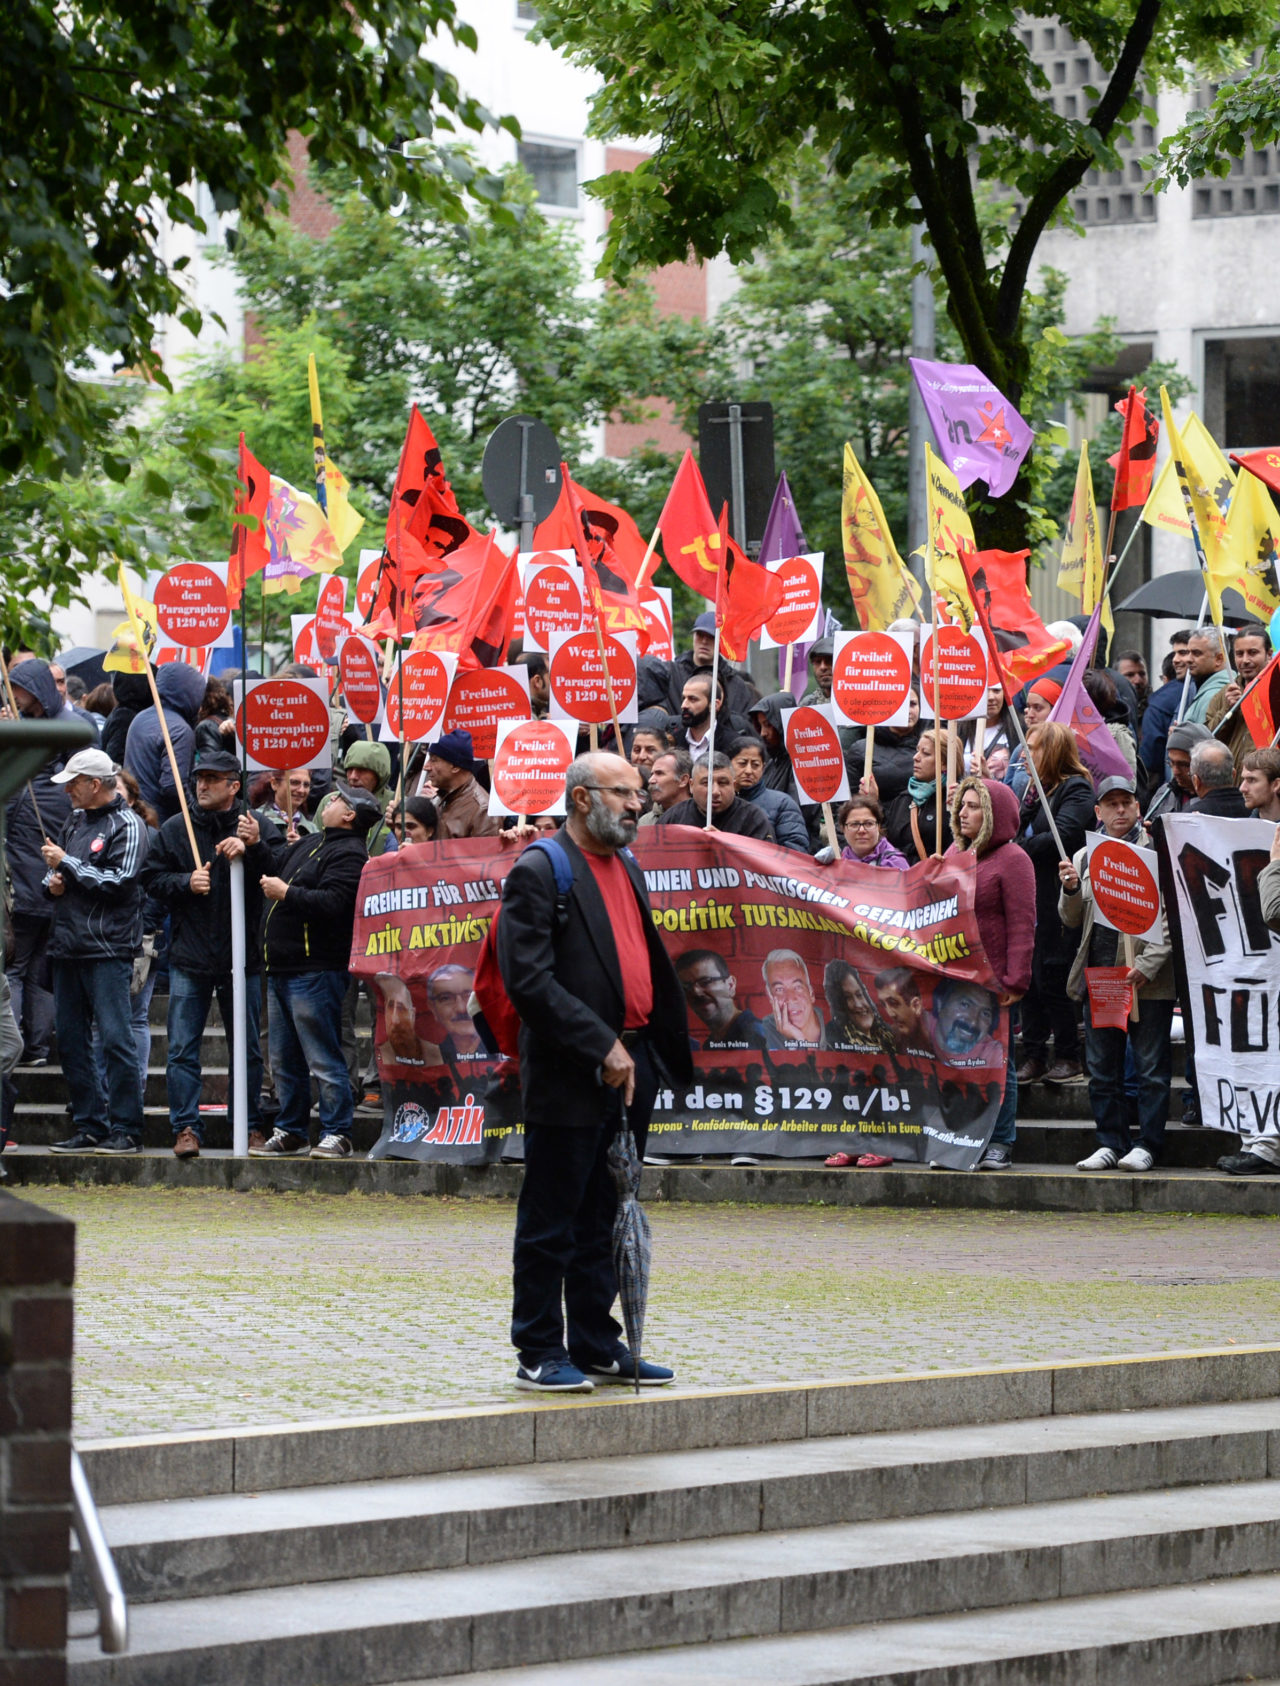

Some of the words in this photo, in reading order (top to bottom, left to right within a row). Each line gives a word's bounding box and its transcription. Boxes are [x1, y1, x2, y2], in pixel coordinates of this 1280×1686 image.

[168, 576, 193, 588] Weg
[195, 576, 213, 586] mit
[538, 579, 555, 592] Weg
[556, 581, 570, 591] mit
[783, 574, 807, 587] reiheit
[181, 590, 201, 600] den
[546, 594, 561, 604] den
[784, 589, 811, 600] unsere
[158, 603, 227, 616] Paragraphen
[528, 606, 580, 620] Paragraphen
[167, 618, 174, 630] §
[177, 617, 197, 628] 129
[199, 617, 219, 628] a/b!
[541, 621, 556, 632] 129
[568, 646, 595, 659] Weg
[851, 651, 893, 663] Freiheit
[405, 665, 421, 678] Weg
[423, 666, 439, 677] mit
[581, 661, 604, 672] den
[844, 666, 861, 677] für
[862, 667, 898, 677] unsere
[929, 659, 943, 670] fr
[943, 662, 976, 672] unsere
[410, 680, 425, 691] den
[836, 679, 905, 692] FreundInnen
[923, 673, 983, 687] FrundInnen
[460, 686, 508, 700] Freiheit
[565, 690, 572, 704] §
[574, 690, 598, 701] 129
[255, 694, 284, 707] Weg
[286, 694, 308, 704] mit
[270, 709, 294, 720] den
[455, 704, 473, 715] für
[475, 701, 515, 713] unsere
[403, 710, 415, 720] 29
[415, 710, 434, 720] a/b!
[793, 727, 824, 740] Freiheit
[252, 738, 260, 751] §
[263, 738, 288, 749] 129
[290, 737, 315, 749] a/b!
[514, 740, 556, 752] Freiheit
[794, 743, 806, 754] für
[806, 742, 831, 752] unsere
[507, 755, 523, 767] für
[524, 756, 559, 766] unsere
[794, 756, 840, 769] FreundInnen
[497, 769, 566, 781] FreundInnen
[1103, 856, 1139, 878] Freiheit
[1099, 869, 1113, 882] für
[1114, 876, 1145, 893] unsere
[363, 886, 429, 918] FREIHEIT
[431, 879, 464, 907] FÜR
[463, 879, 500, 903] ALLE
[697, 867, 740, 889] UND
[743, 869, 850, 909] POLITISCHEN
[853, 894, 959, 931] GEFANGENEN!
[1093, 880, 1155, 910] FreundInnen
[653, 1088, 675, 1110] it
[685, 1085, 743, 1110] den
[754, 1087, 833, 1116] §129
[842, 1087, 911, 1118] a/b!
[691, 1119, 759, 1132] Konföderation
[761, 1119, 778, 1132] der
[780, 1120, 818, 1133] Arbeiter
[820, 1122, 838, 1133] aus
[839, 1120, 856, 1133] der
[858, 1120, 886, 1134] Türkei
[887, 1121, 898, 1134] in
